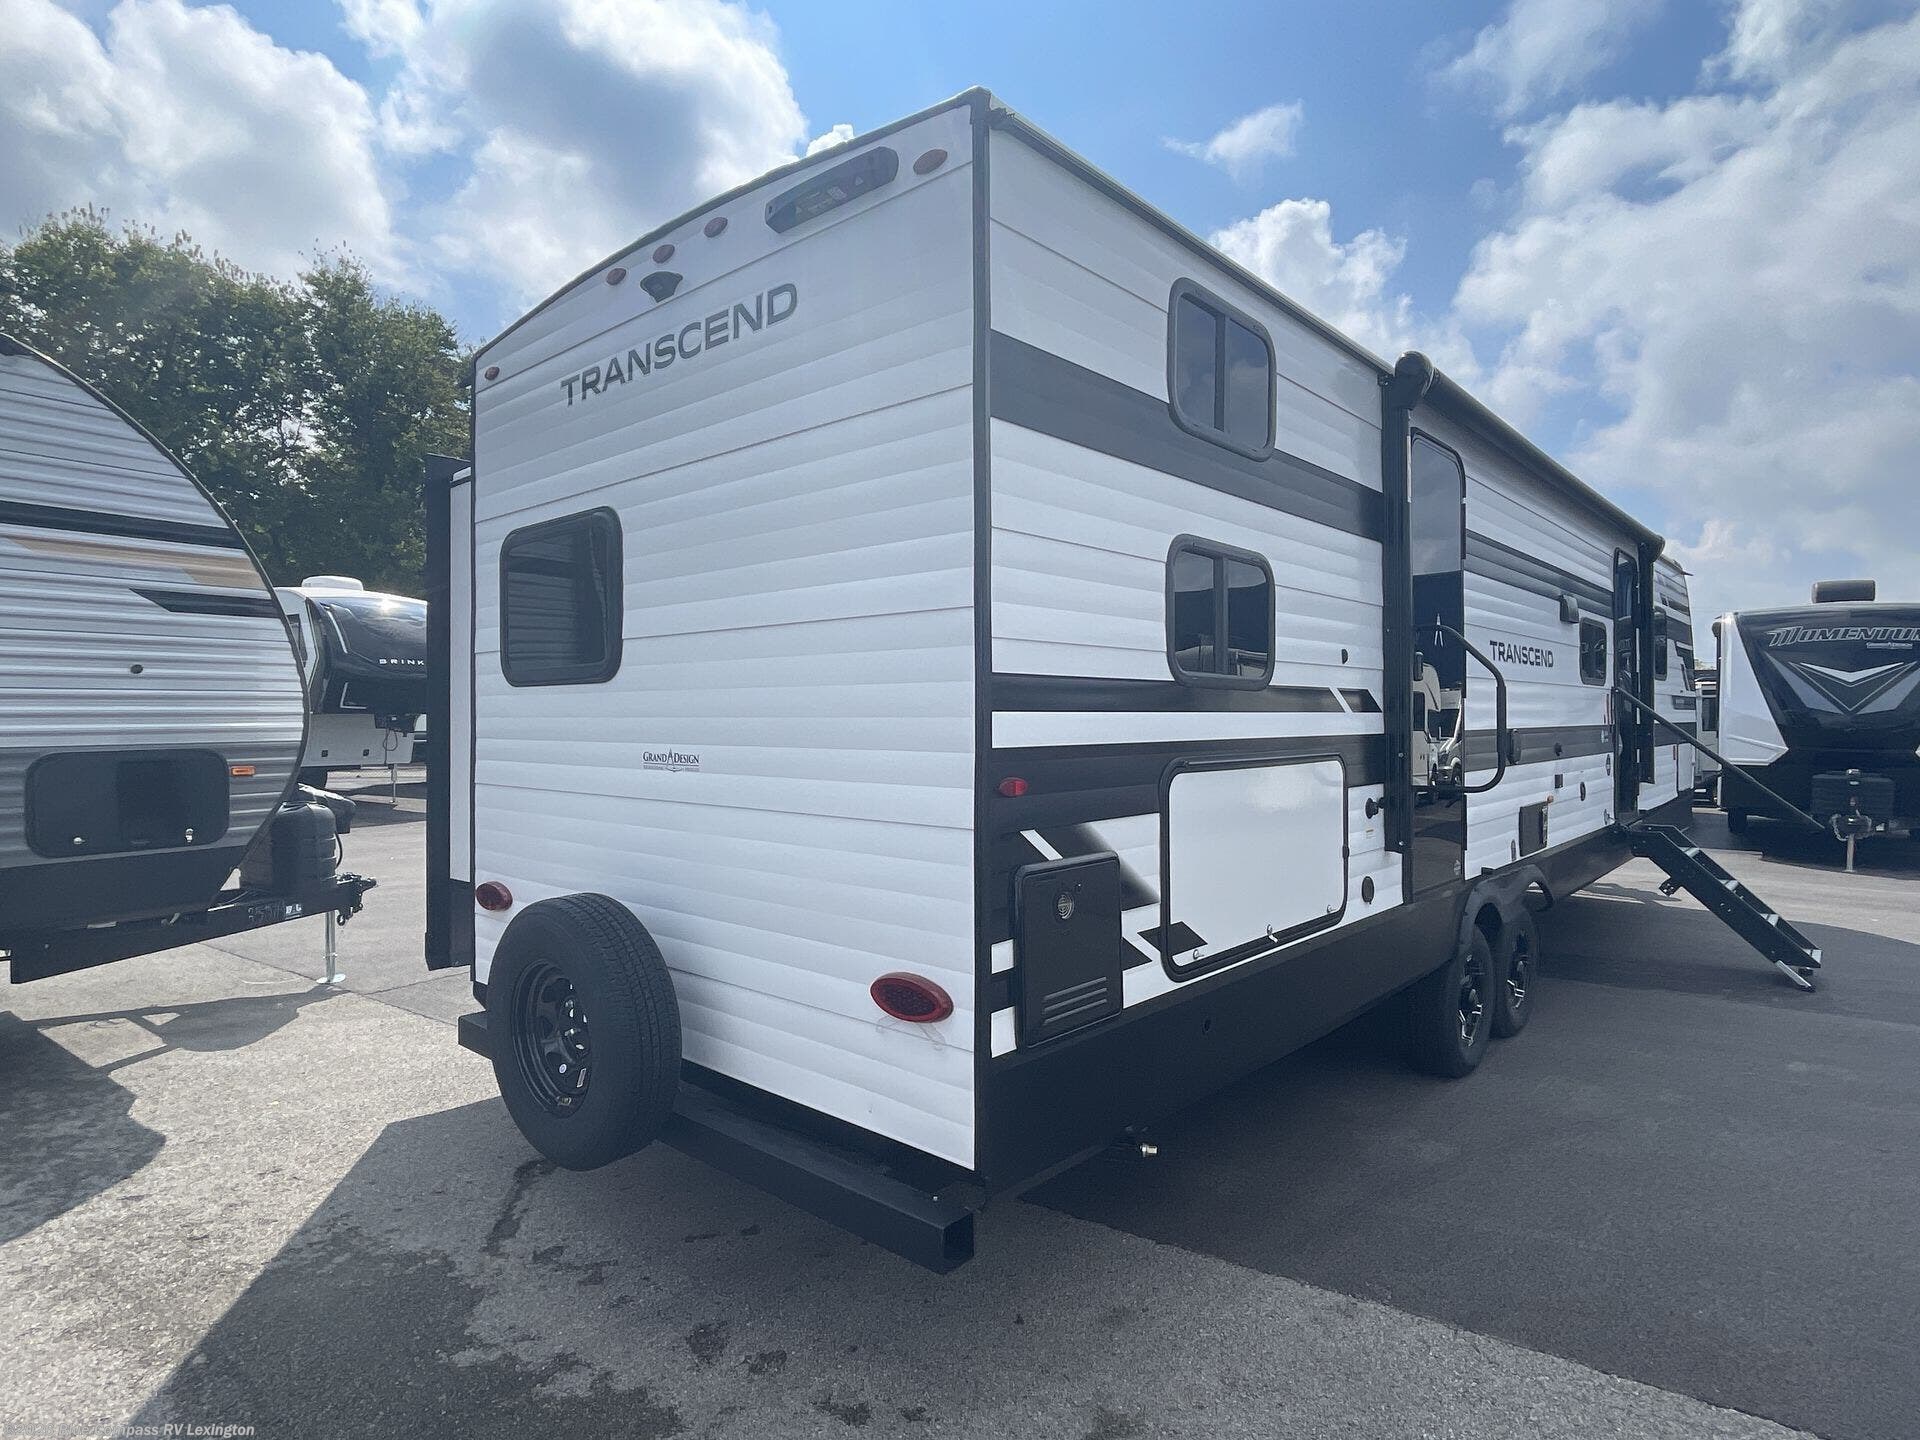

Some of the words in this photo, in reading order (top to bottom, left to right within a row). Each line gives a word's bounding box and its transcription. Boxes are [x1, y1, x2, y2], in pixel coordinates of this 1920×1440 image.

[560, 283, 798, 407] TRANSCEND
[379, 658, 425, 666] BRINK
[1489, 640, 1554, 668] TRANSCEND
[642, 751, 668, 763] GRAND
[673, 752, 700, 764] DESIGN
